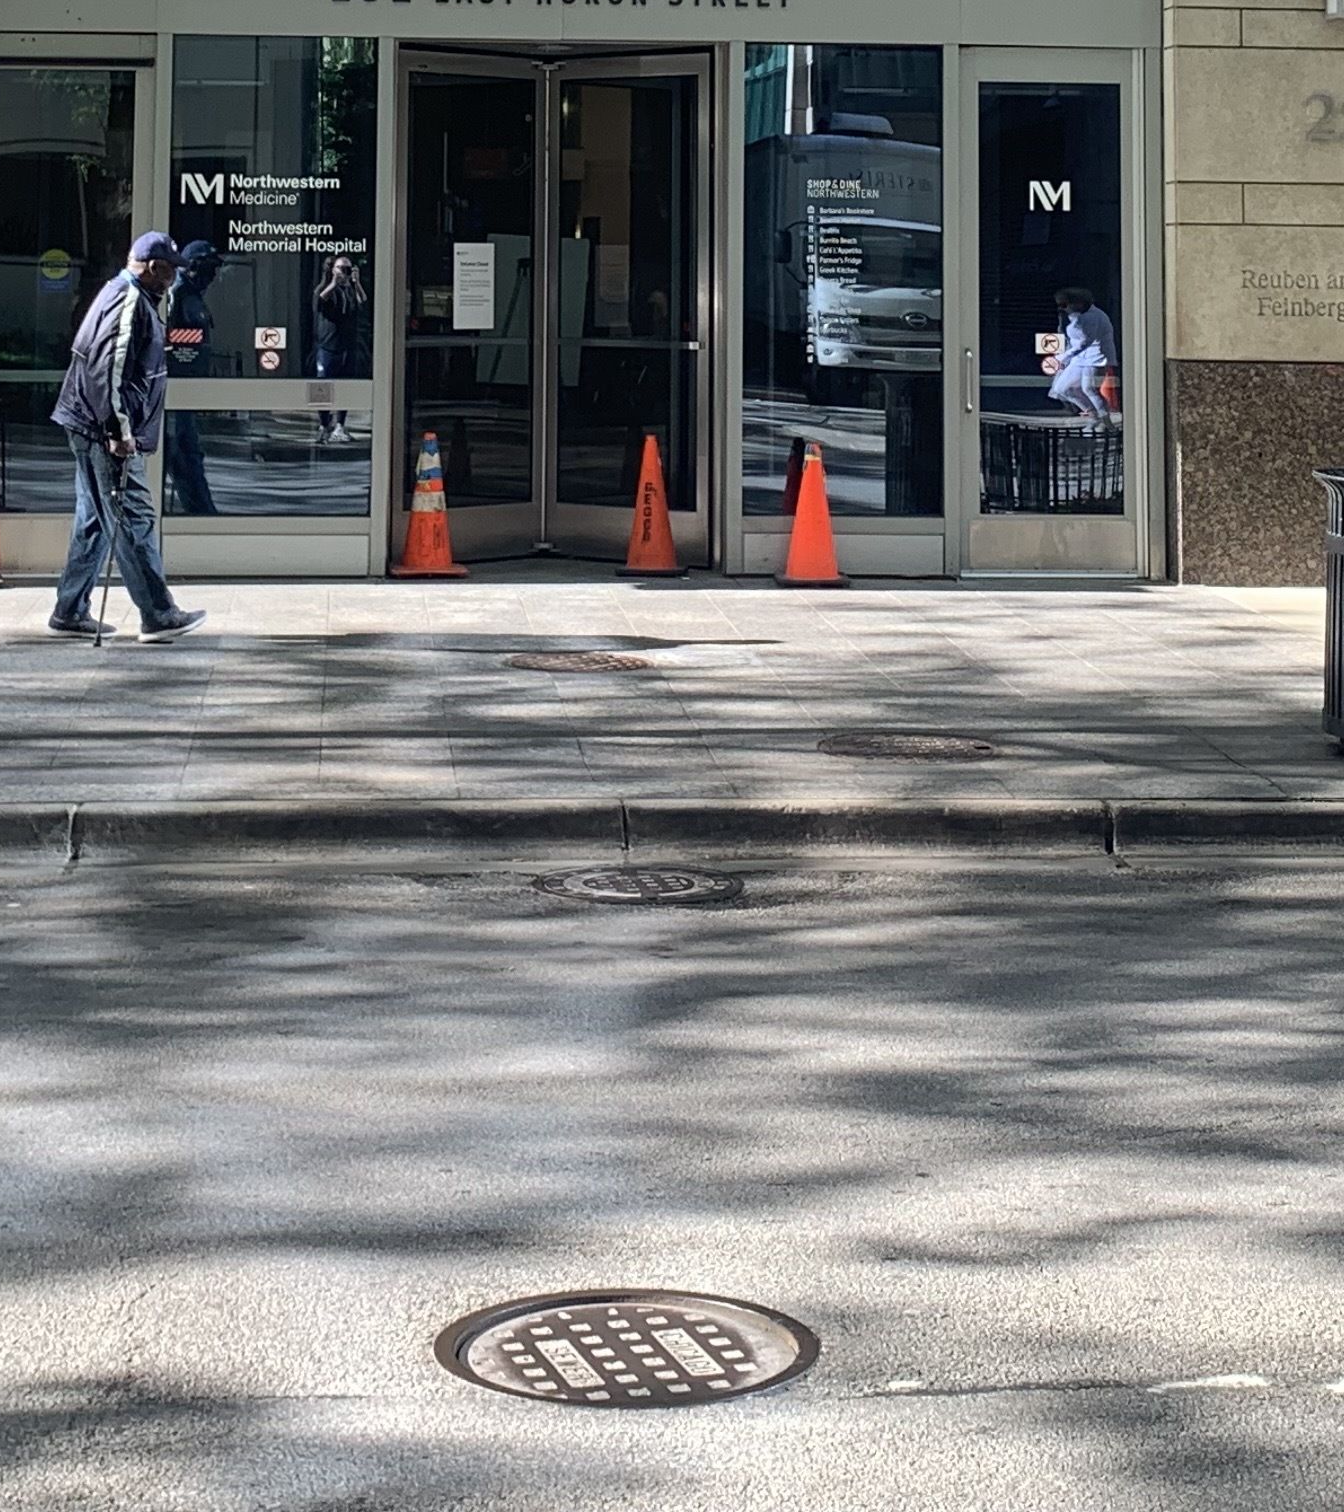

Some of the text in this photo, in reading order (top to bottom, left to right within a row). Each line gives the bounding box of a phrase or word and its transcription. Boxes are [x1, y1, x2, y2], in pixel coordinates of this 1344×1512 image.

[229, 173, 340, 189] Northwestern
[806, 189, 880, 199] NORTHWESTERN
[228, 220, 333, 235] Northwestern
[228, 237, 367, 255] Memorial Hospital
[1241, 269, 1319, 289] Reuben
